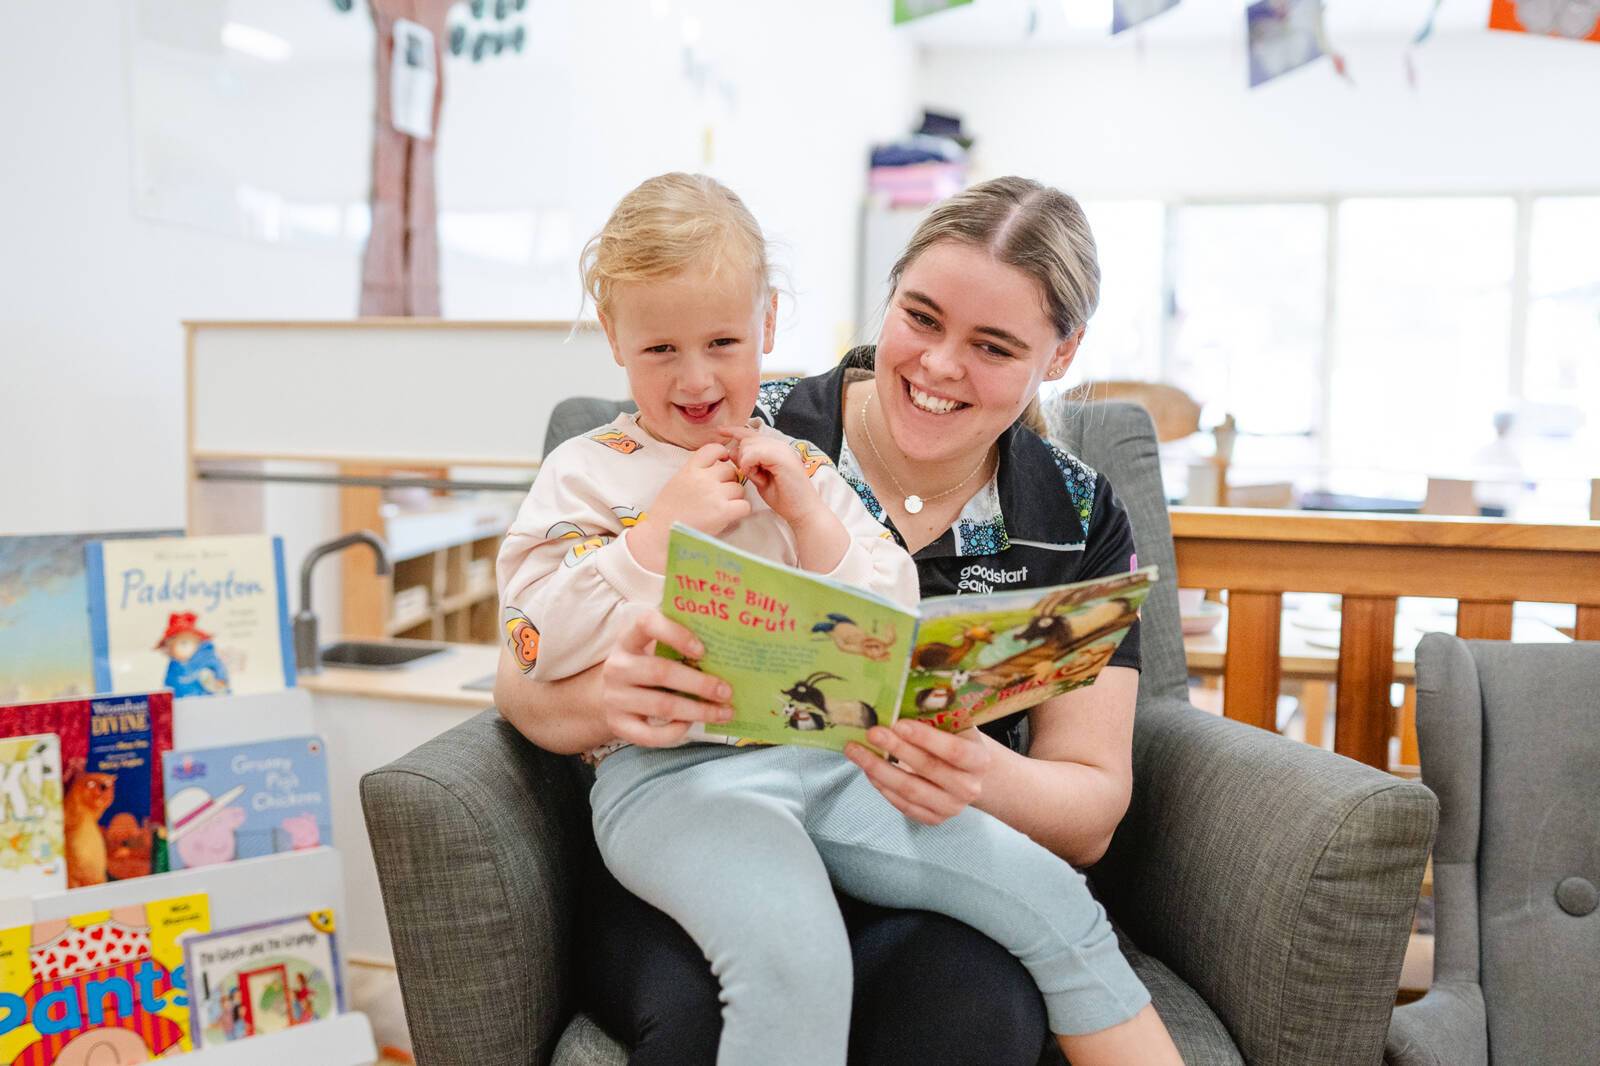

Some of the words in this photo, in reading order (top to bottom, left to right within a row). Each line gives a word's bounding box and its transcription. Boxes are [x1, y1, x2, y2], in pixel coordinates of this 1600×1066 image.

[715, 570, 741, 586] The
[960, 565, 1028, 583] goodstart
[120, 567, 264, 612] Paddington
[957, 579, 993, 595] early
[745, 590, 789, 616] Billy
[92, 711, 150, 736] DIVINE
